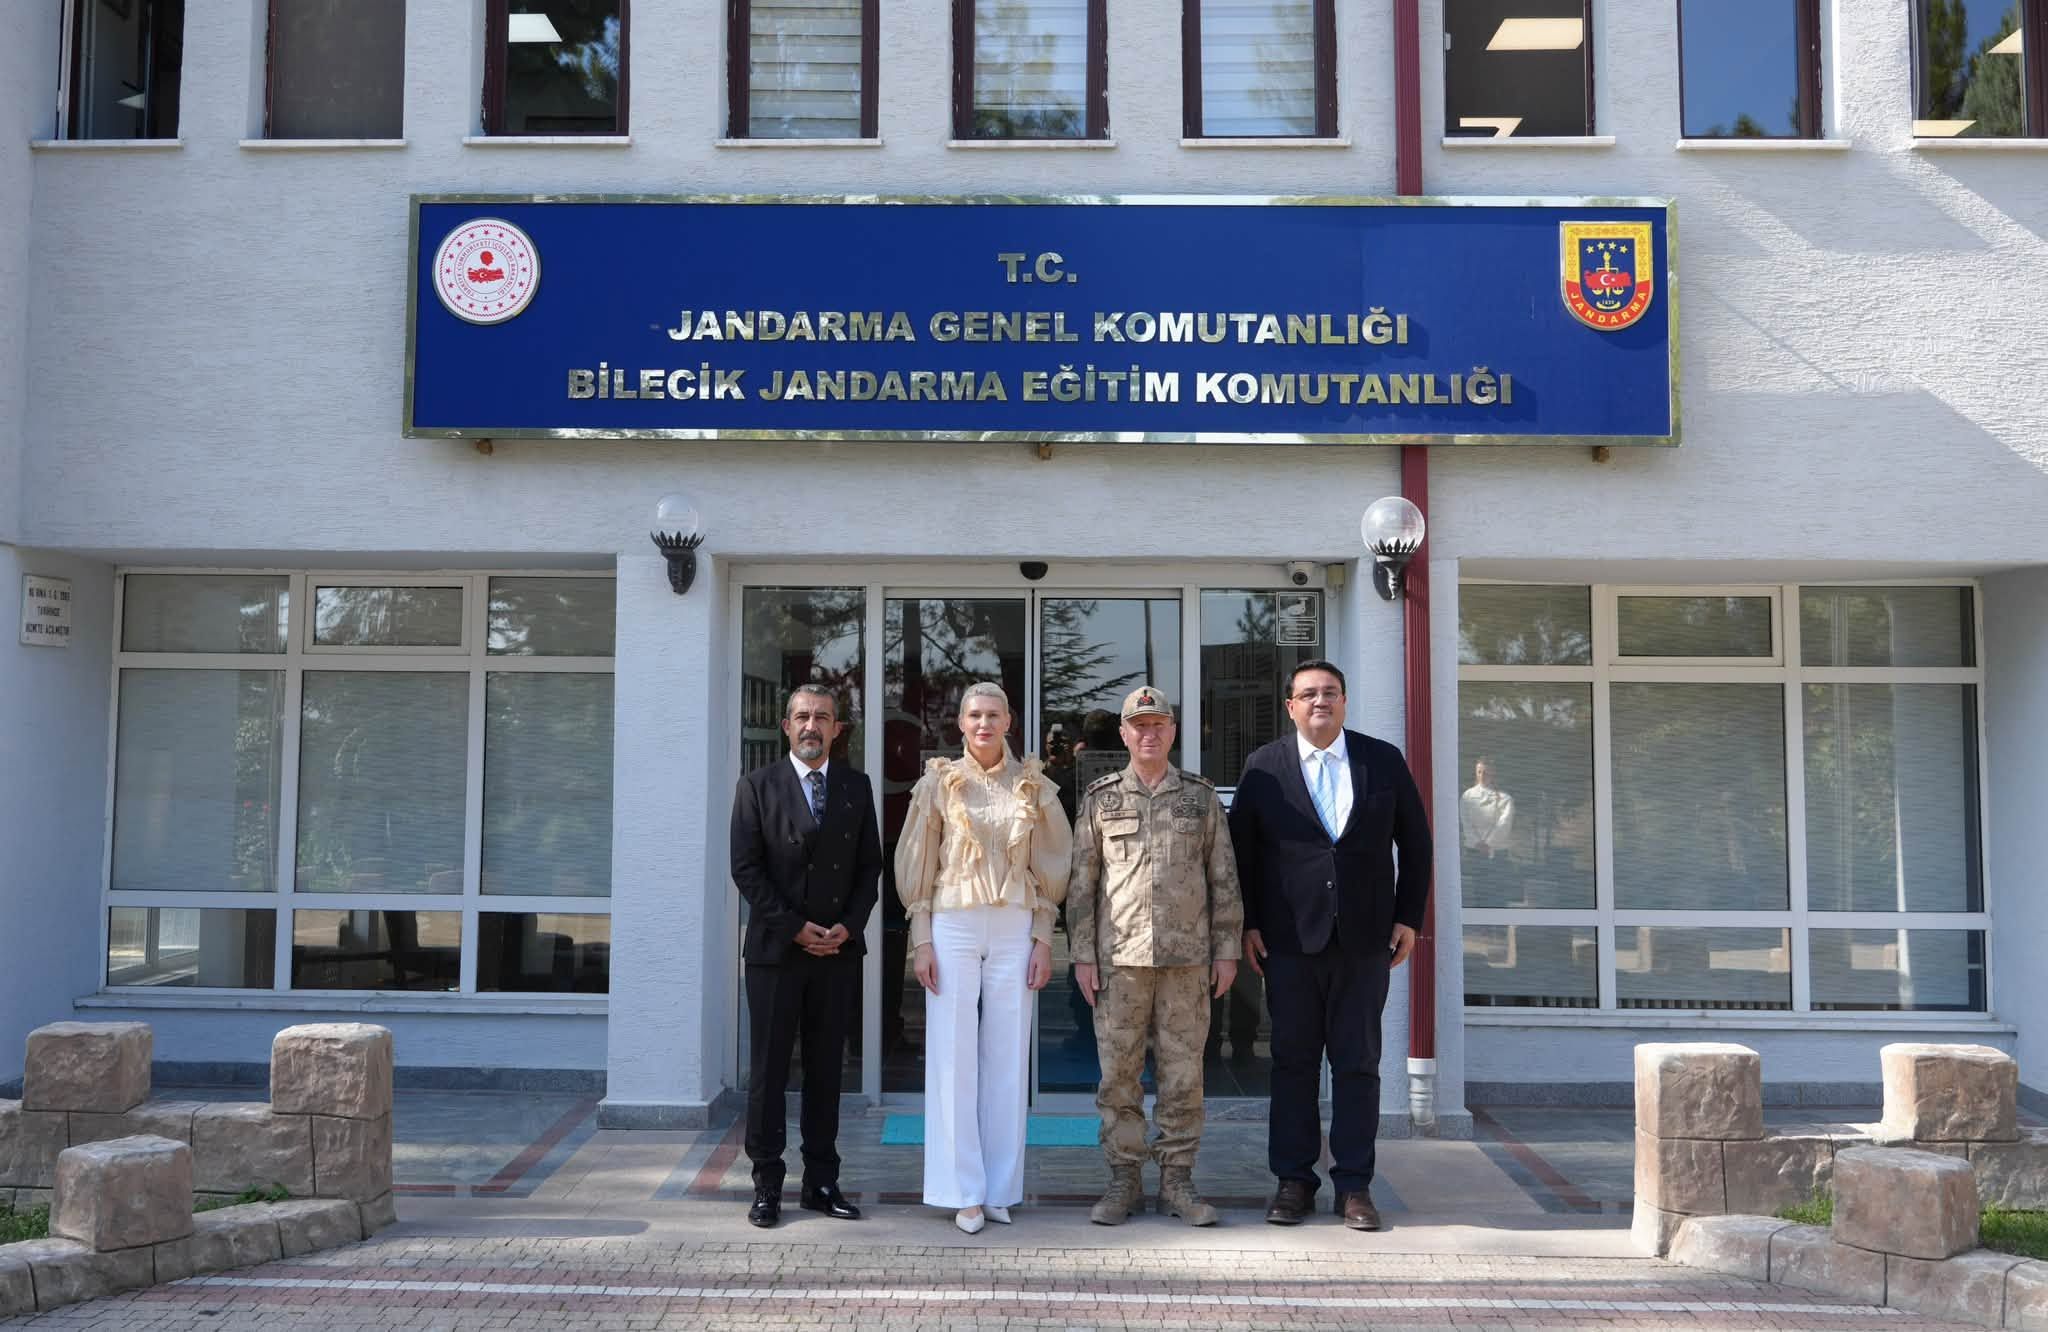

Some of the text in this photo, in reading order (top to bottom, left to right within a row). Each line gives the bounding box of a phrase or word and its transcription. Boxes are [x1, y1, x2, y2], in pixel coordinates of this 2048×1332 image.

[998, 252, 1077, 283] T.C.
[667, 306, 1408, 344] JANDARMA GENEL KOMUTANLIĞI
[1570, 292, 1647, 324] JANDARMA
[567, 362, 1512, 404] BİLECİK JANDARMA EĞİTİM KOMUTANLIĞI
